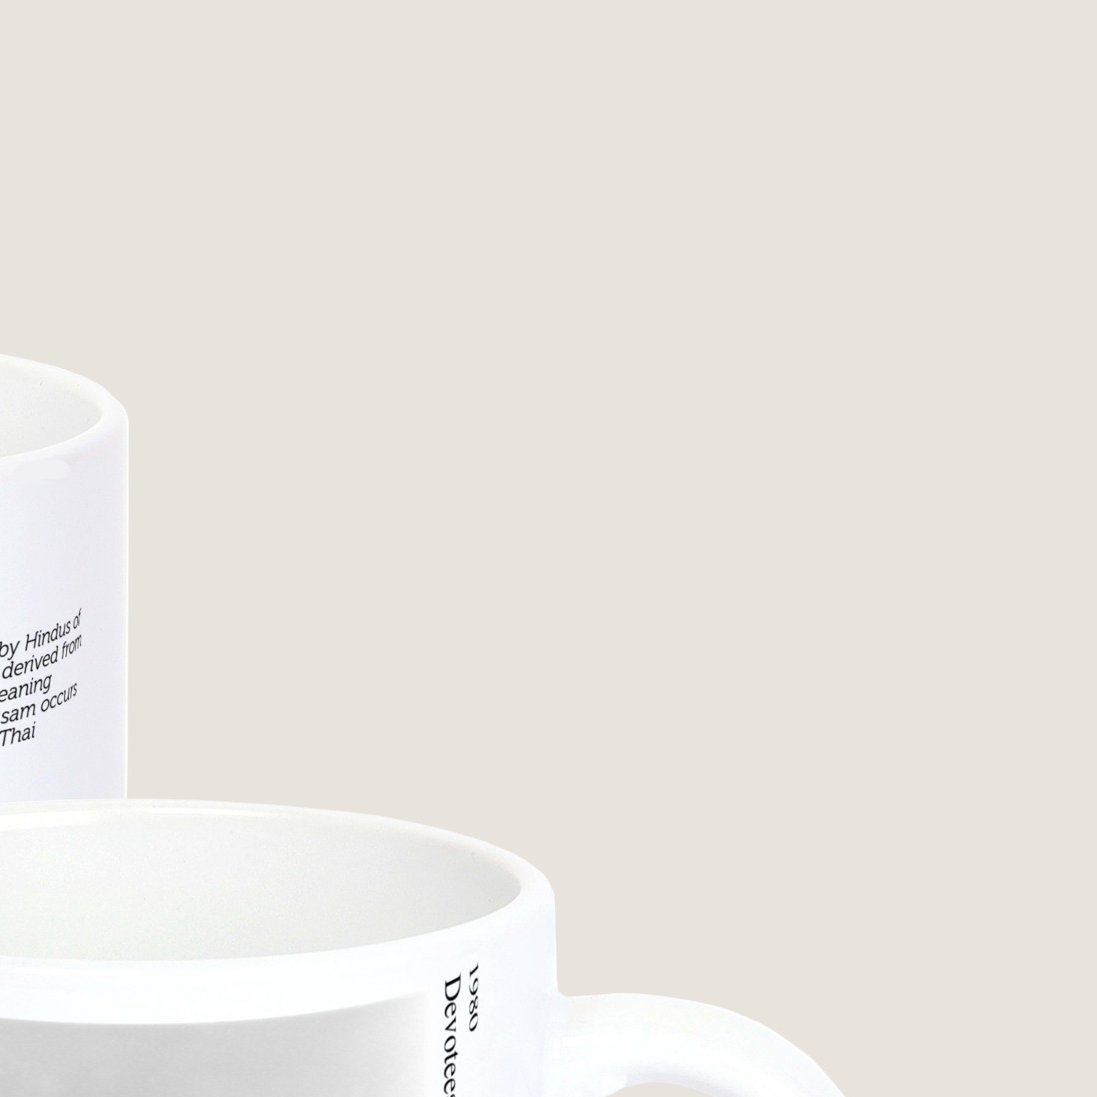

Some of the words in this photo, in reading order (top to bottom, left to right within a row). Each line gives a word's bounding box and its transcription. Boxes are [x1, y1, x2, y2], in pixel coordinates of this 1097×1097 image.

[25, 621, 71, 651] Hindus
[2, 646, 59, 680] derived
[62, 635, 81, 659] from
[41, 683, 77, 712] occurs
[0, 721, 36, 746] Thai
[468, 962, 479, 1032] 1980
